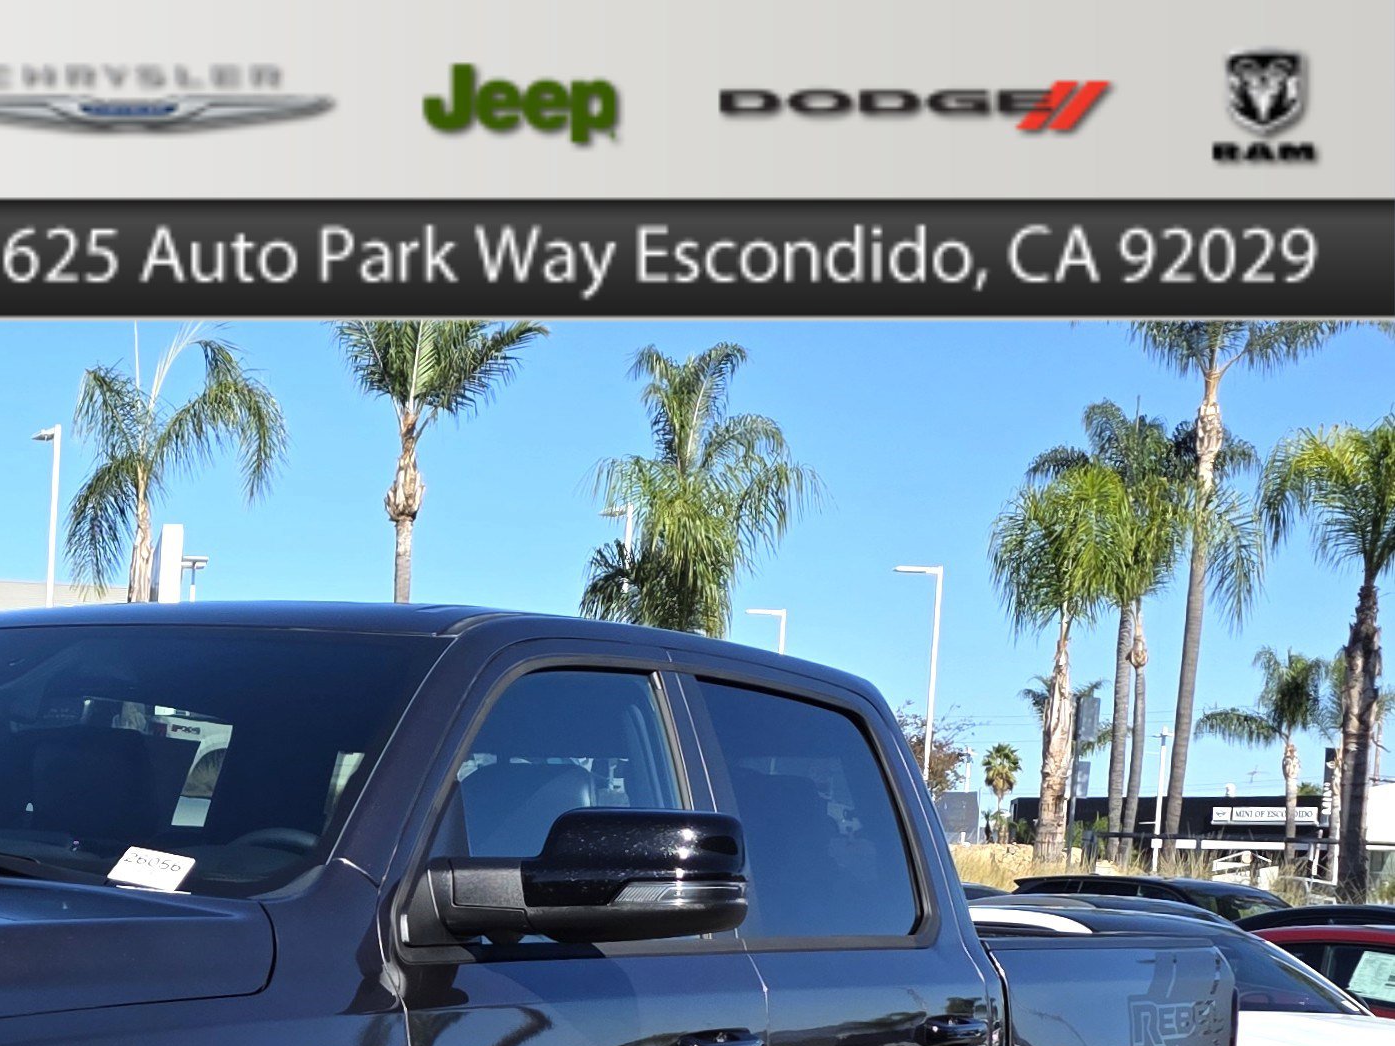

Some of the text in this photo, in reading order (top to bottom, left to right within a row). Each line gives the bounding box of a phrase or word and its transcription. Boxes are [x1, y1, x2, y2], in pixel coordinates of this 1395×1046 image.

[1235, 810, 1313, 818] MINI OF ESCODIDO
